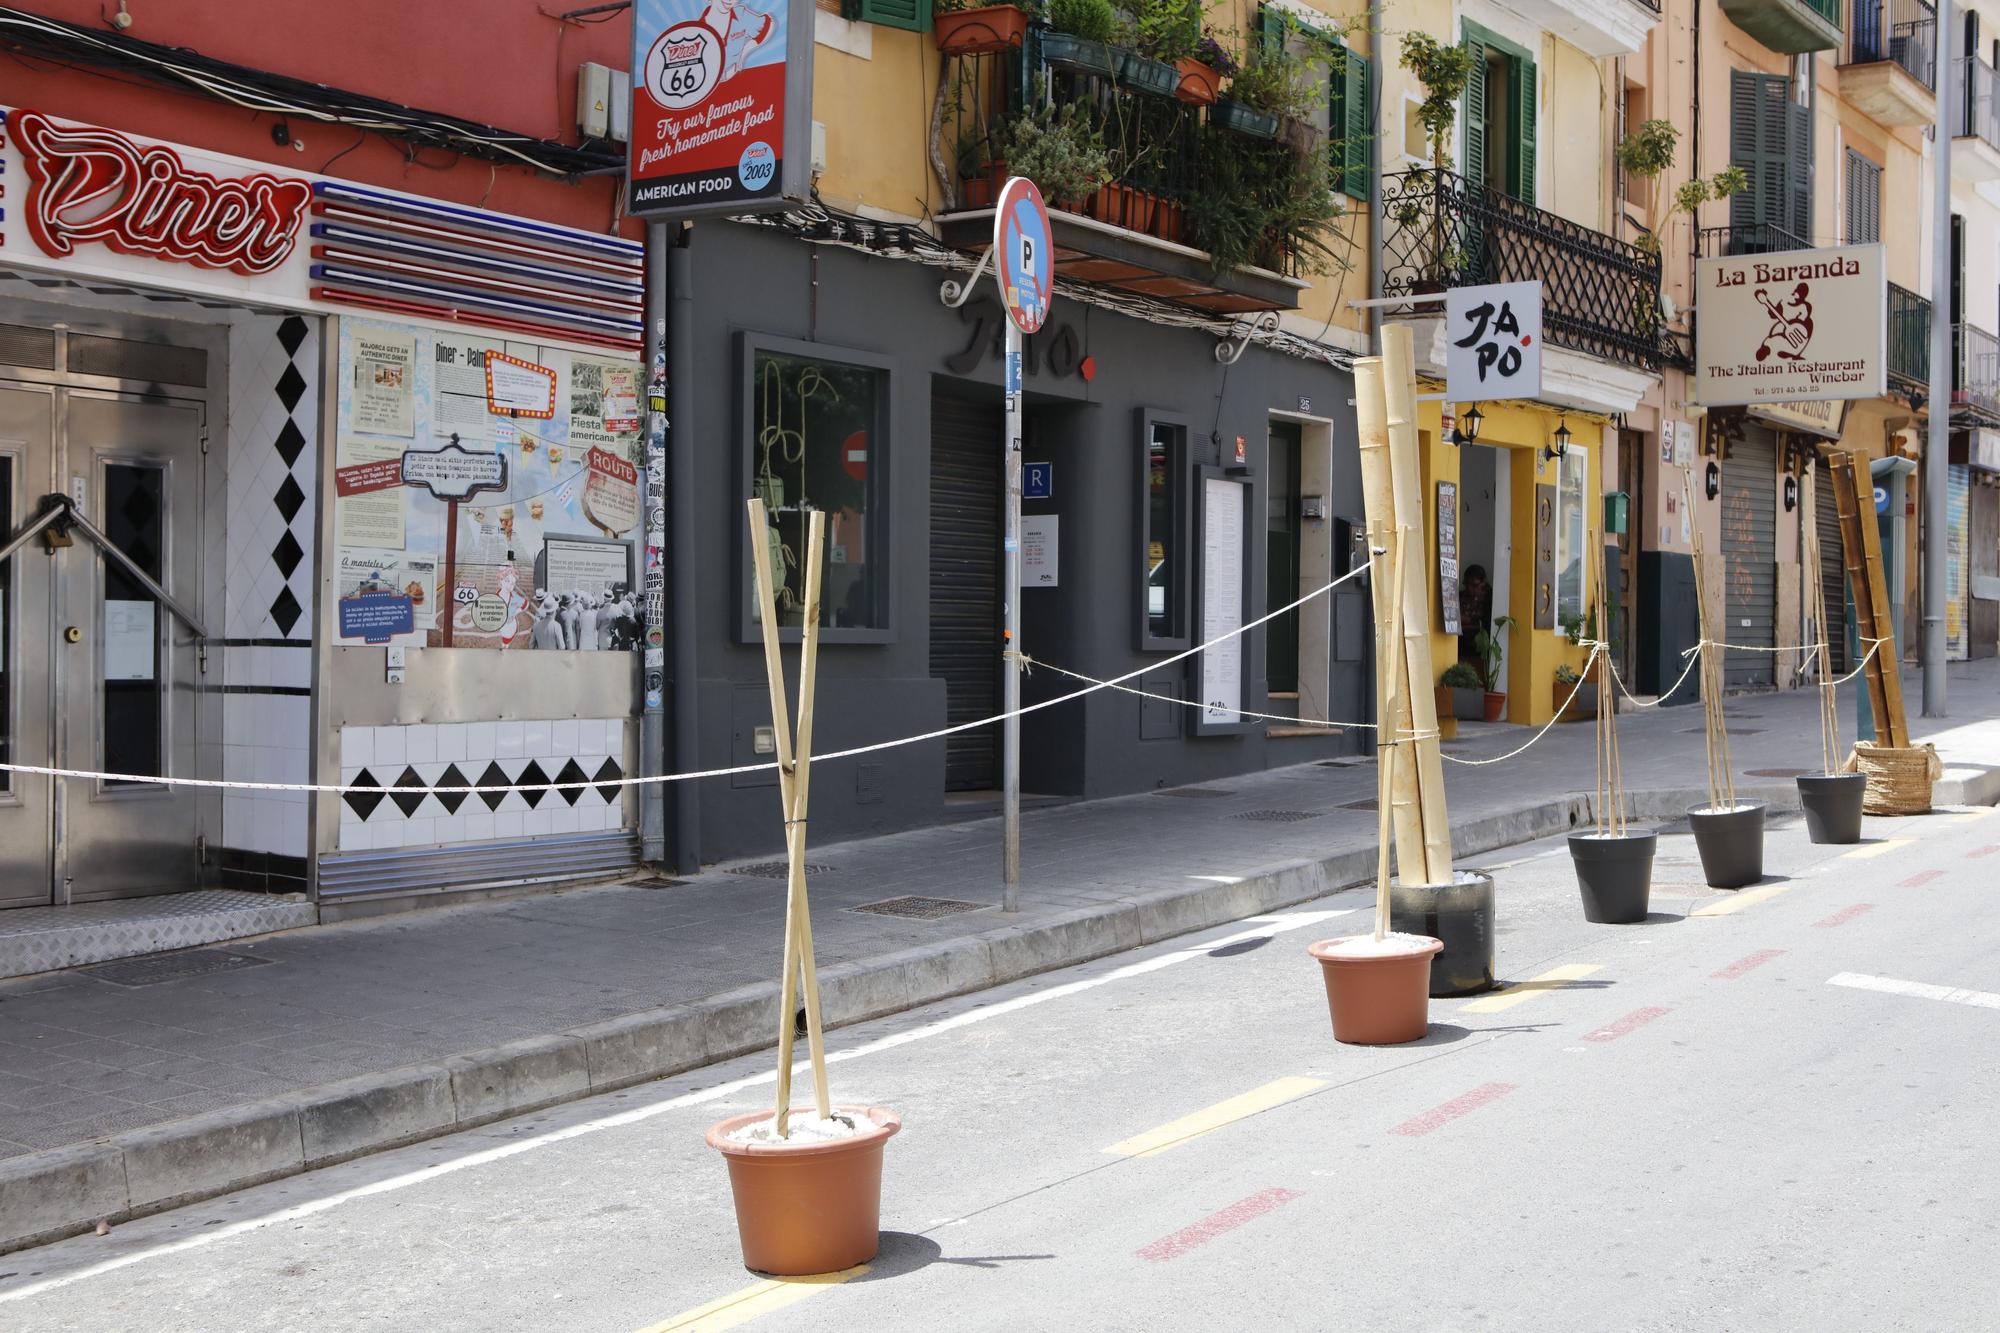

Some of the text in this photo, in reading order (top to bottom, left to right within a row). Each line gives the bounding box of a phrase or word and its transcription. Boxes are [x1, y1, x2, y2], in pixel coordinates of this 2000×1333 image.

[671, 67, 695, 91] 66
[657, 95, 754, 140] Try our famous
[640, 104, 774, 172] fresh homemade food
[744, 163, 773, 180] 2003
[7, 109, 313, 275] Diner
[635, 177, 732, 201] AMERICAN FOOD
[1023, 239, 1033, 269] P
[1716, 256, 1860, 287] La Baranda
[360, 342, 385, 351] MAJORCA
[361, 350, 391, 360] AUTHENTIC
[435, 341, 457, 363] Diner
[1708, 359, 1865, 378] The Italian Restaurant
[1809, 372, 1865, 383] Winebar
[1300, 399, 1310, 410] 25
[571, 417, 601, 430] Fiesta
[570, 431, 615, 442] americana
[593, 452, 633, 480] ROUTE
[1031, 469, 1042, 486] R
[341, 557, 384, 568] A manteles
[458, 590, 475, 600] 66
